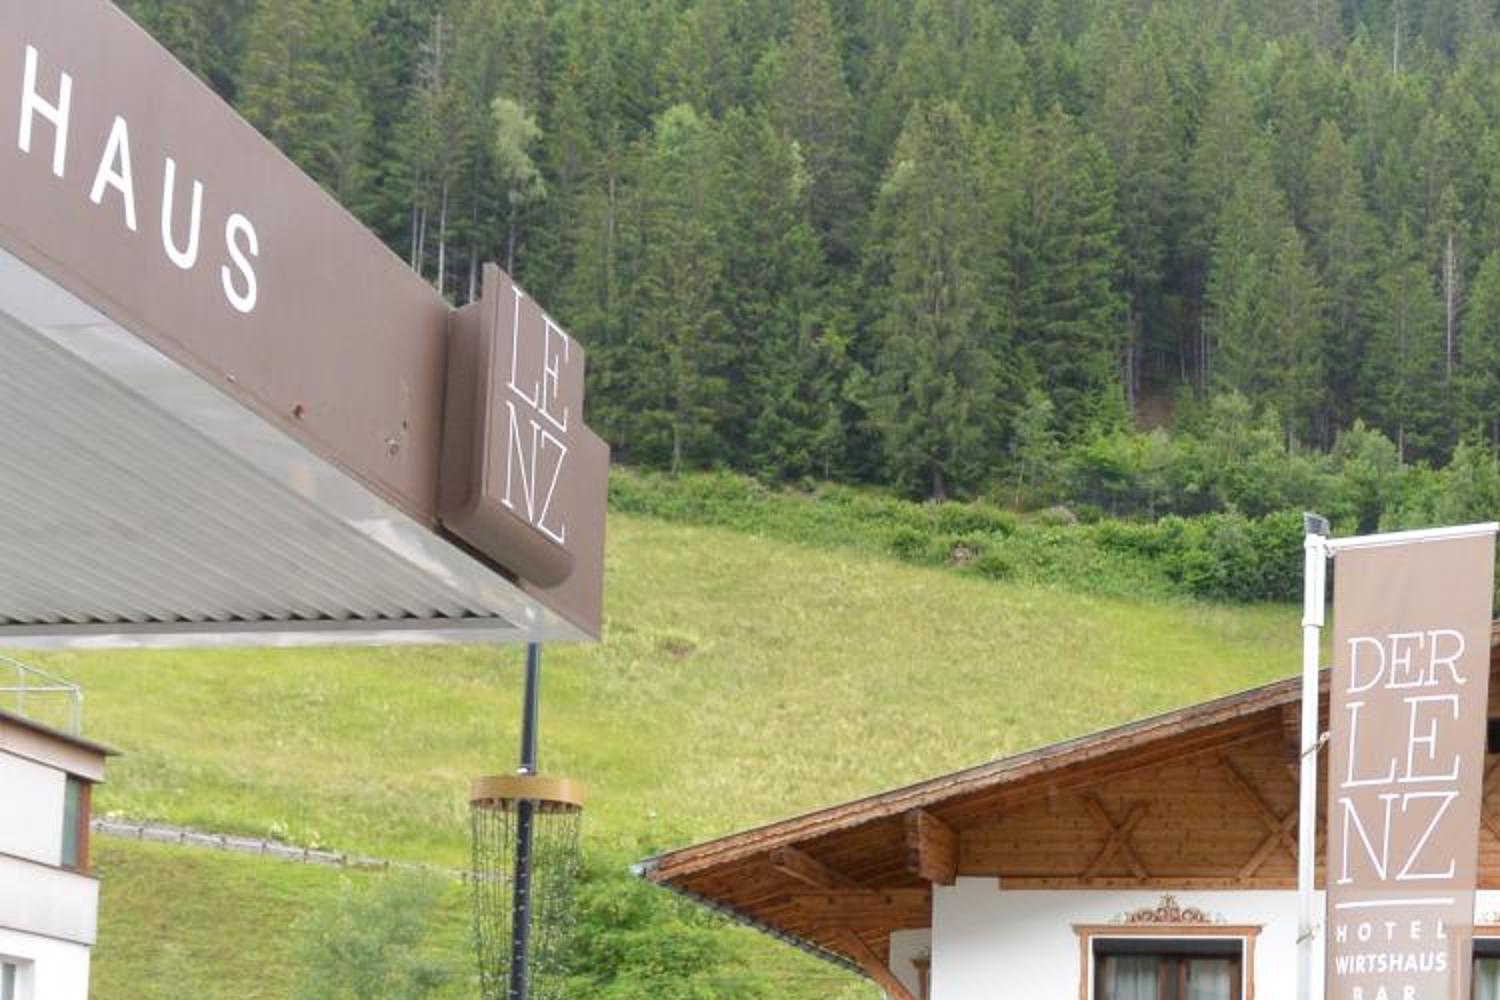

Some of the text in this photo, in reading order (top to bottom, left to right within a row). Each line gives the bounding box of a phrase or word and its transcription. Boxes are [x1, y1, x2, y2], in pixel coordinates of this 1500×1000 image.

[17, 45, 260, 314] HAUS
[1345, 629, 1467, 694] DER
[1336, 922, 1449, 943] HOTEL
[1335, 950, 1448, 976] WIRTSHAUS
